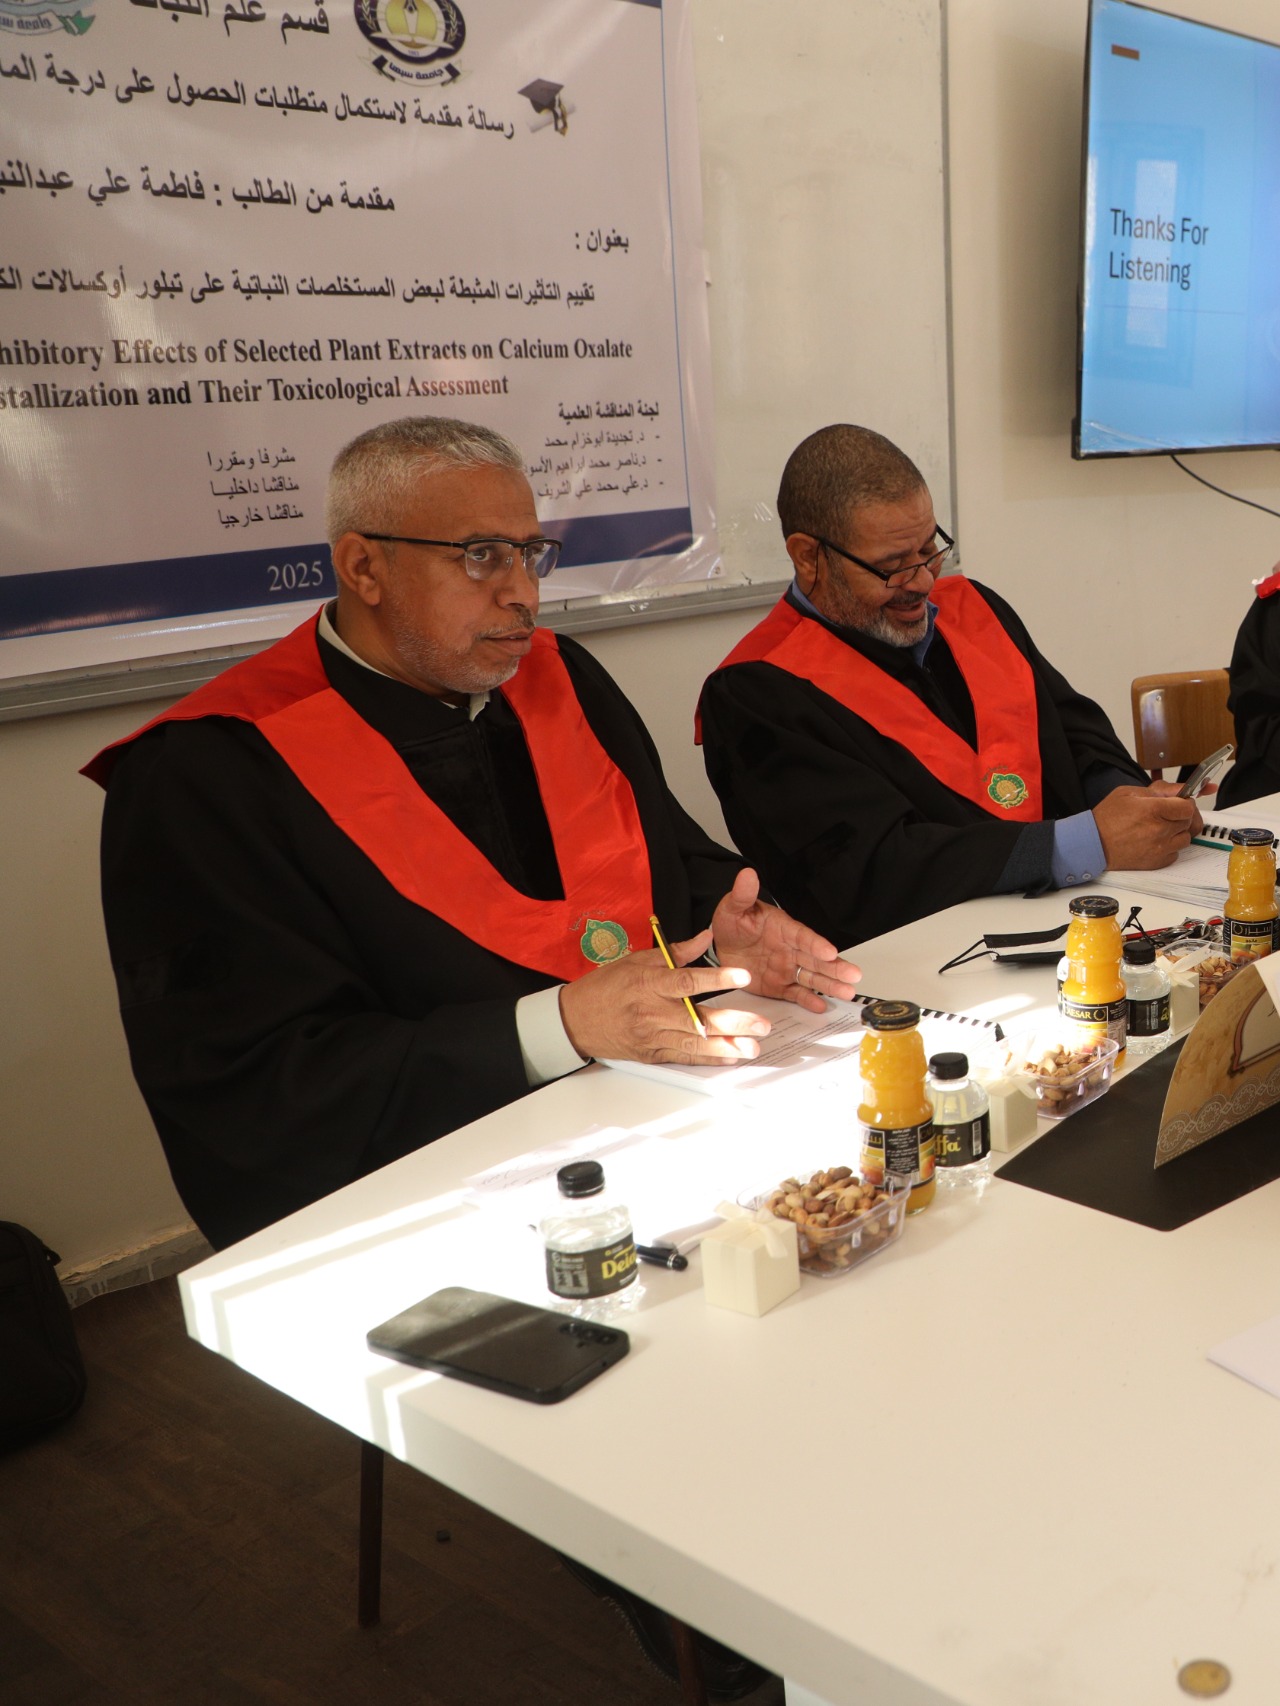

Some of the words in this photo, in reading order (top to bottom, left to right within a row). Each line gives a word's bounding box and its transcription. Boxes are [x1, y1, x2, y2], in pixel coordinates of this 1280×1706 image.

[281, 0, 330, 44] قسم
[45, 53, 106, 96] درجة
[115, 67, 155, 104] على
[167, 72, 246, 107] الحصول
[254, 86, 329, 117] متطلبات
[335, 93, 407, 124] لاستكمال
[414, 97, 463, 128] مقدمة
[468, 104, 514, 139] رسالة
[88, 166, 131, 204] علي
[141, 166, 205, 200] فاطمة
[232, 178, 297, 210] الطالب
[340, 180, 395, 212] مقدمة
[306, 186, 334, 213] من
[586, 228, 629, 253] بعنوان
[1109, 207, 1176, 242] Thanks
[1181, 216, 1209, 246] For
[32, 265, 127, 298] أوكسالات
[136, 270, 183, 299] تبلور
[232, 270, 290, 301] النباتية
[296, 269, 395, 298] المستخلصات
[1109, 250, 1192, 291] Listening
[190, 270, 225, 303] على
[402, 278, 445, 304] لبعض
[449, 276, 499, 304] المثبطة
[505, 278, 561, 306] التأثيرات
[566, 284, 595, 309] تقييم
[112, 339, 198, 365] Effects
[205, 339, 228, 363] of
[234, 338, 322, 363] Selected
[328, 338, 381, 362] Plant
[387, 338, 467, 361] Extracts
[471, 342, 494, 360] on
[499, 338, 569, 360] Calcium
[573, 338, 633, 359] Oxalate
[147, 380, 192, 406] and
[198, 379, 262, 404] Their
[266, 376, 401, 404] Toxicological
[406, 375, 509, 398] Assessment
[558, 402, 592, 426] العلمية
[595, 400, 635, 420] المناقشة
[637, 400, 659, 422] لجنة
[257, 447, 296, 468] مشرفا
[262, 475, 299, 493] مناقشا
[217, 506, 264, 529] خارجيا
[266, 503, 304, 521] مناقشا
[267, 560, 324, 592] 2025
[1066, 1007, 1092, 1020] AESAR
